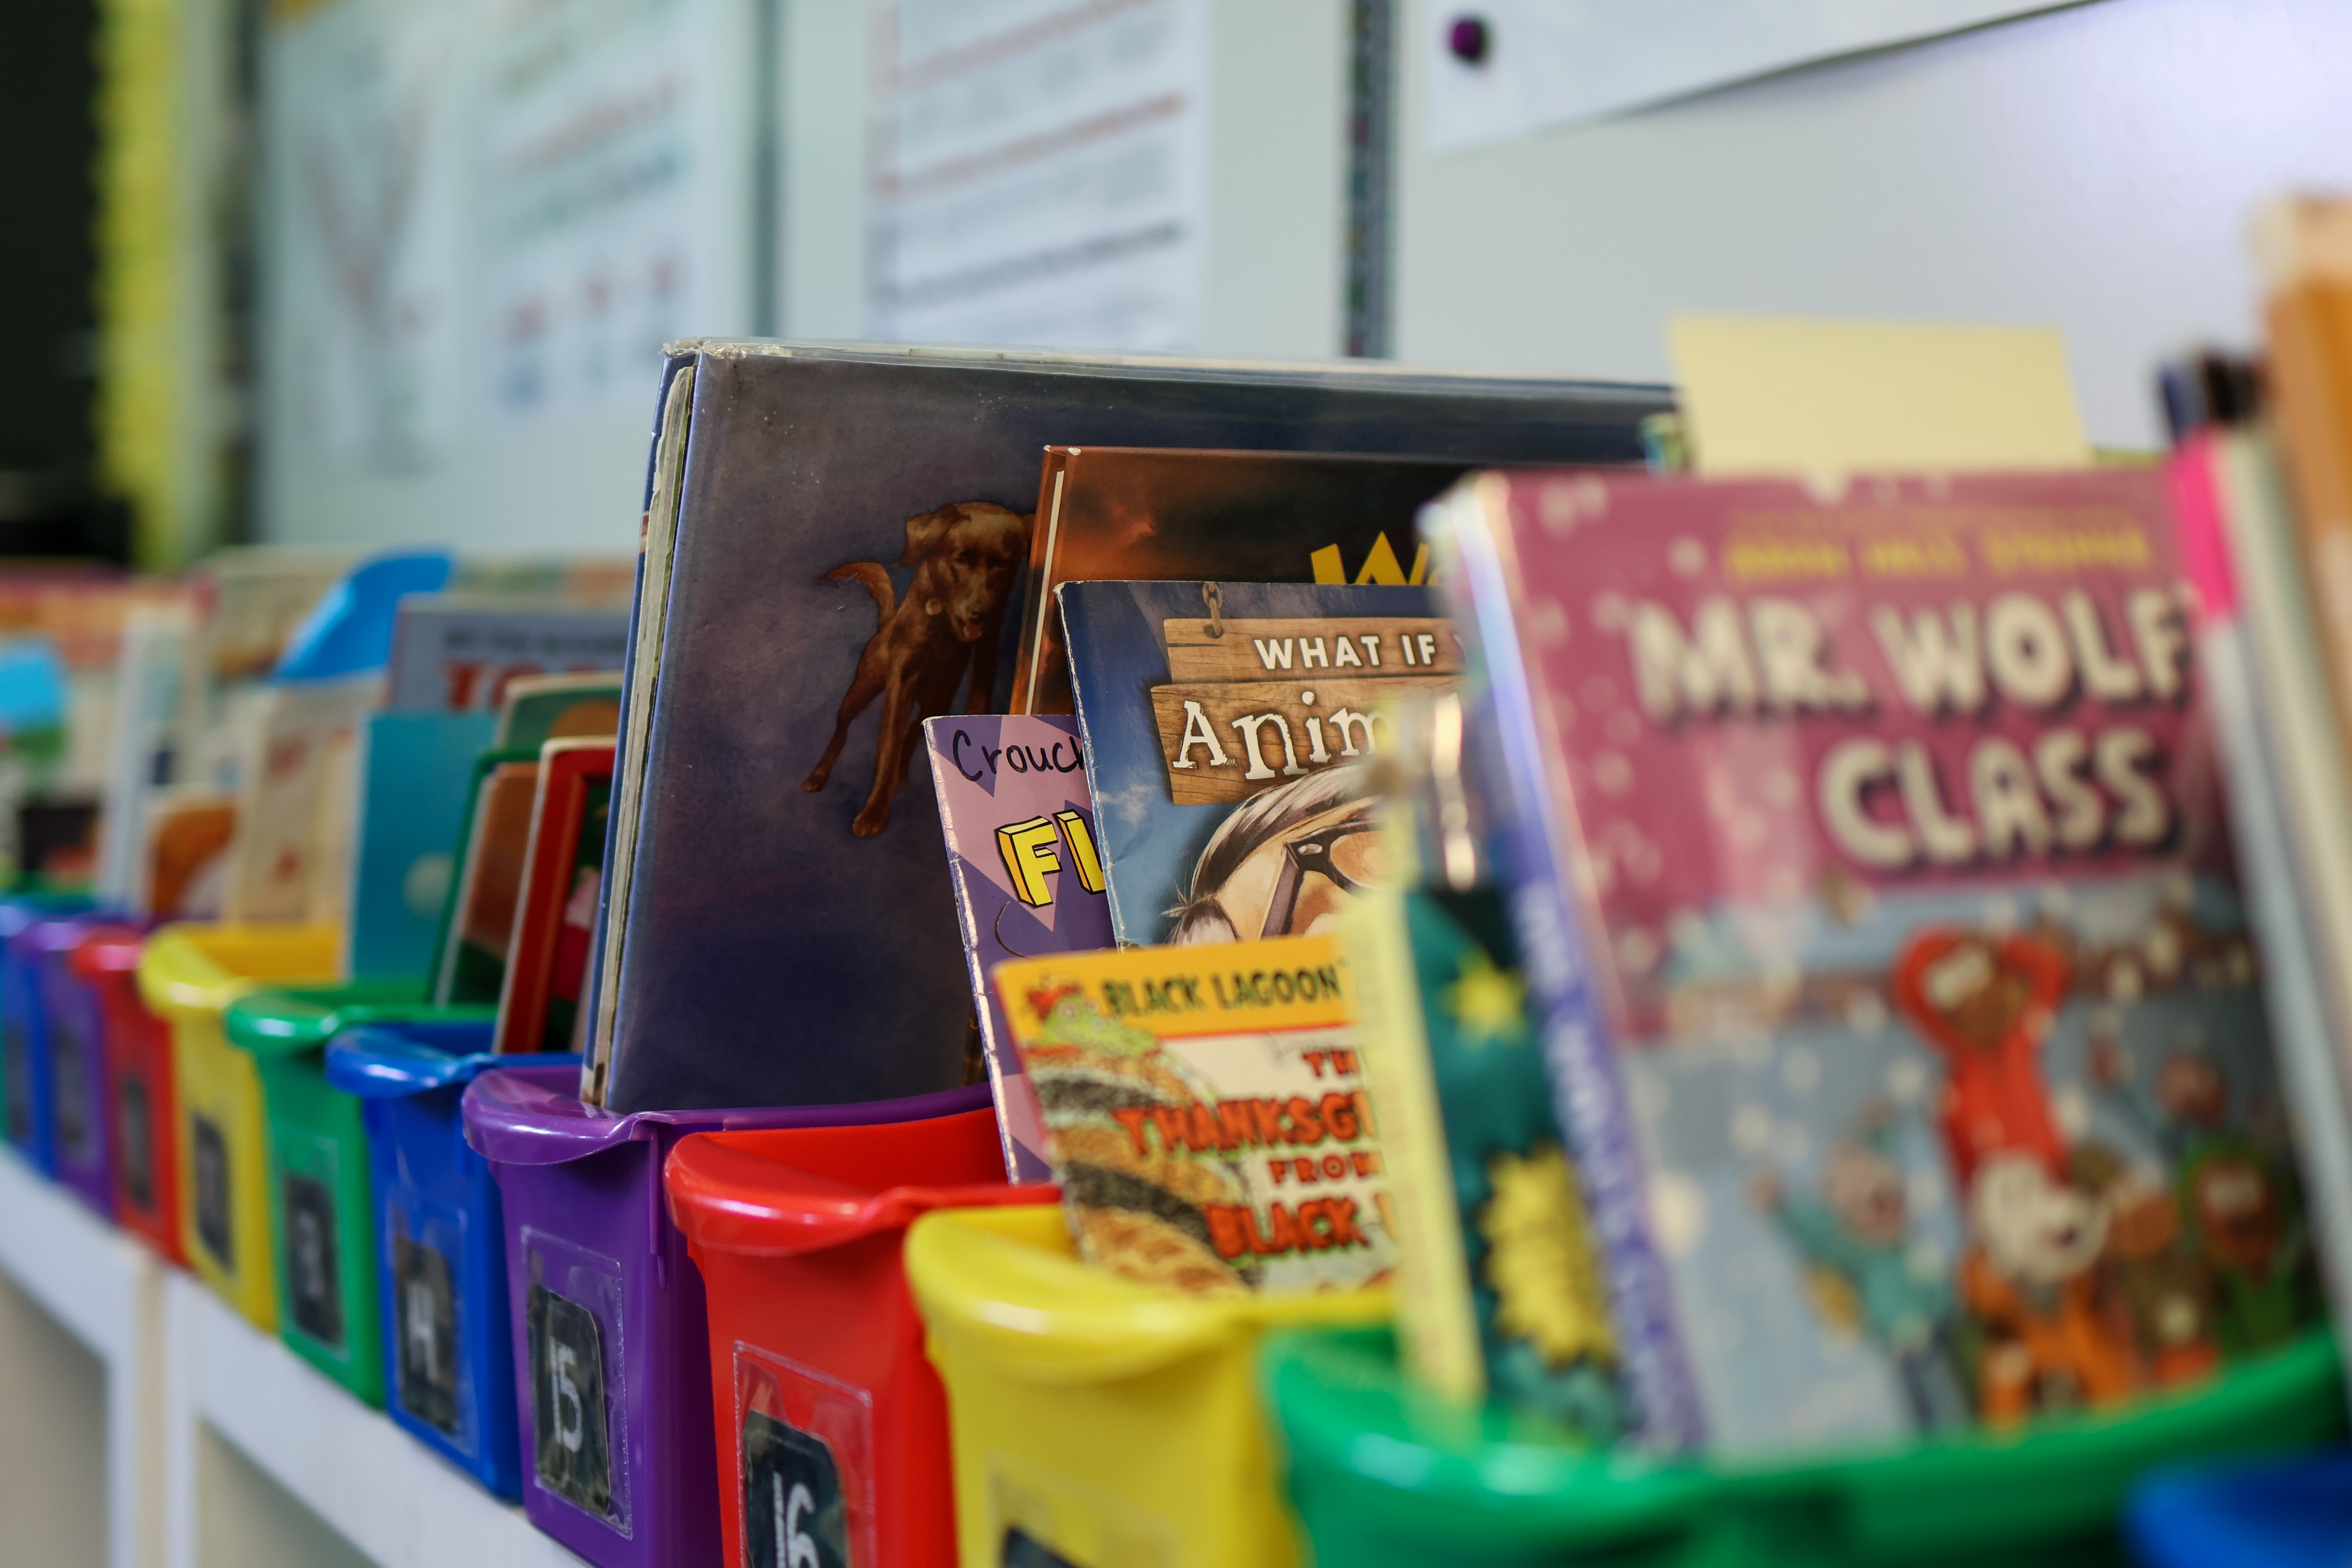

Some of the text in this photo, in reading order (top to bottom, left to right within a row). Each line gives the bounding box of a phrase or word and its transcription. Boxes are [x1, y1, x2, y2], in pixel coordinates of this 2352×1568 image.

[1254, 634, 1381, 670] WHAT
[1401, 633, 1436, 666] IF
[1631, 592, 1870, 723] MR.
[1817, 723, 2168, 868] CLASS
[1103, 966, 1341, 1017] BLACK LAGOON
[1203, 1196, 1370, 1258] BLACK
[549, 1336, 583, 1454] 15
[772, 1471, 822, 1568] 16
